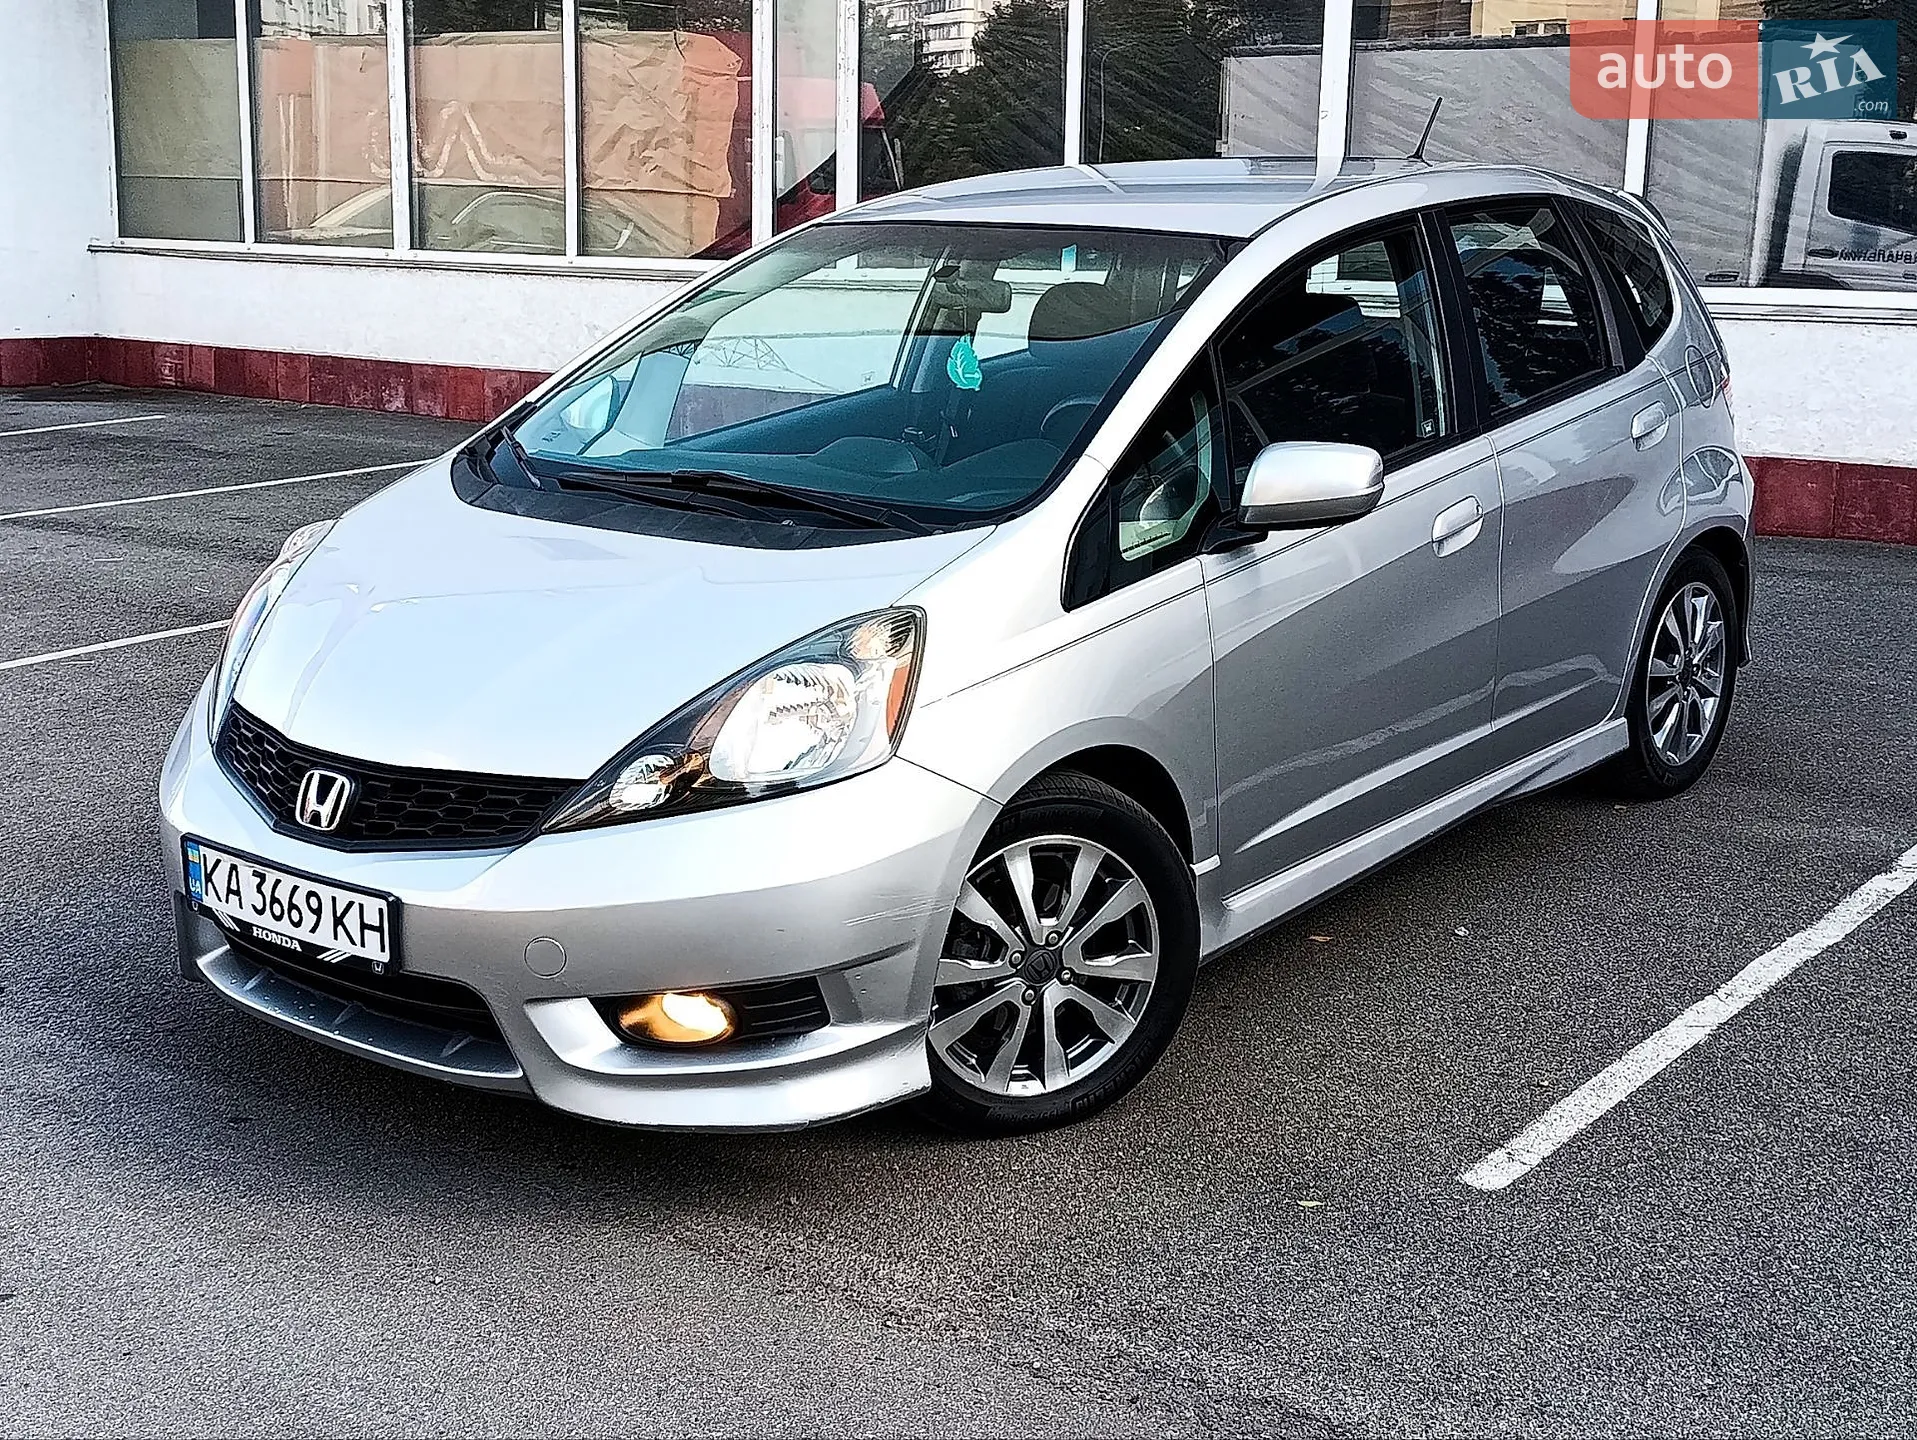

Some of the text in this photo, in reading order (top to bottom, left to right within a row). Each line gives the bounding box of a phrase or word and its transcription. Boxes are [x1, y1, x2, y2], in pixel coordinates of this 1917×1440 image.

[188, 875, 202, 894] UA
[203, 853, 386, 953] KA 3669 KH
[252, 926, 302, 951] HONDA
